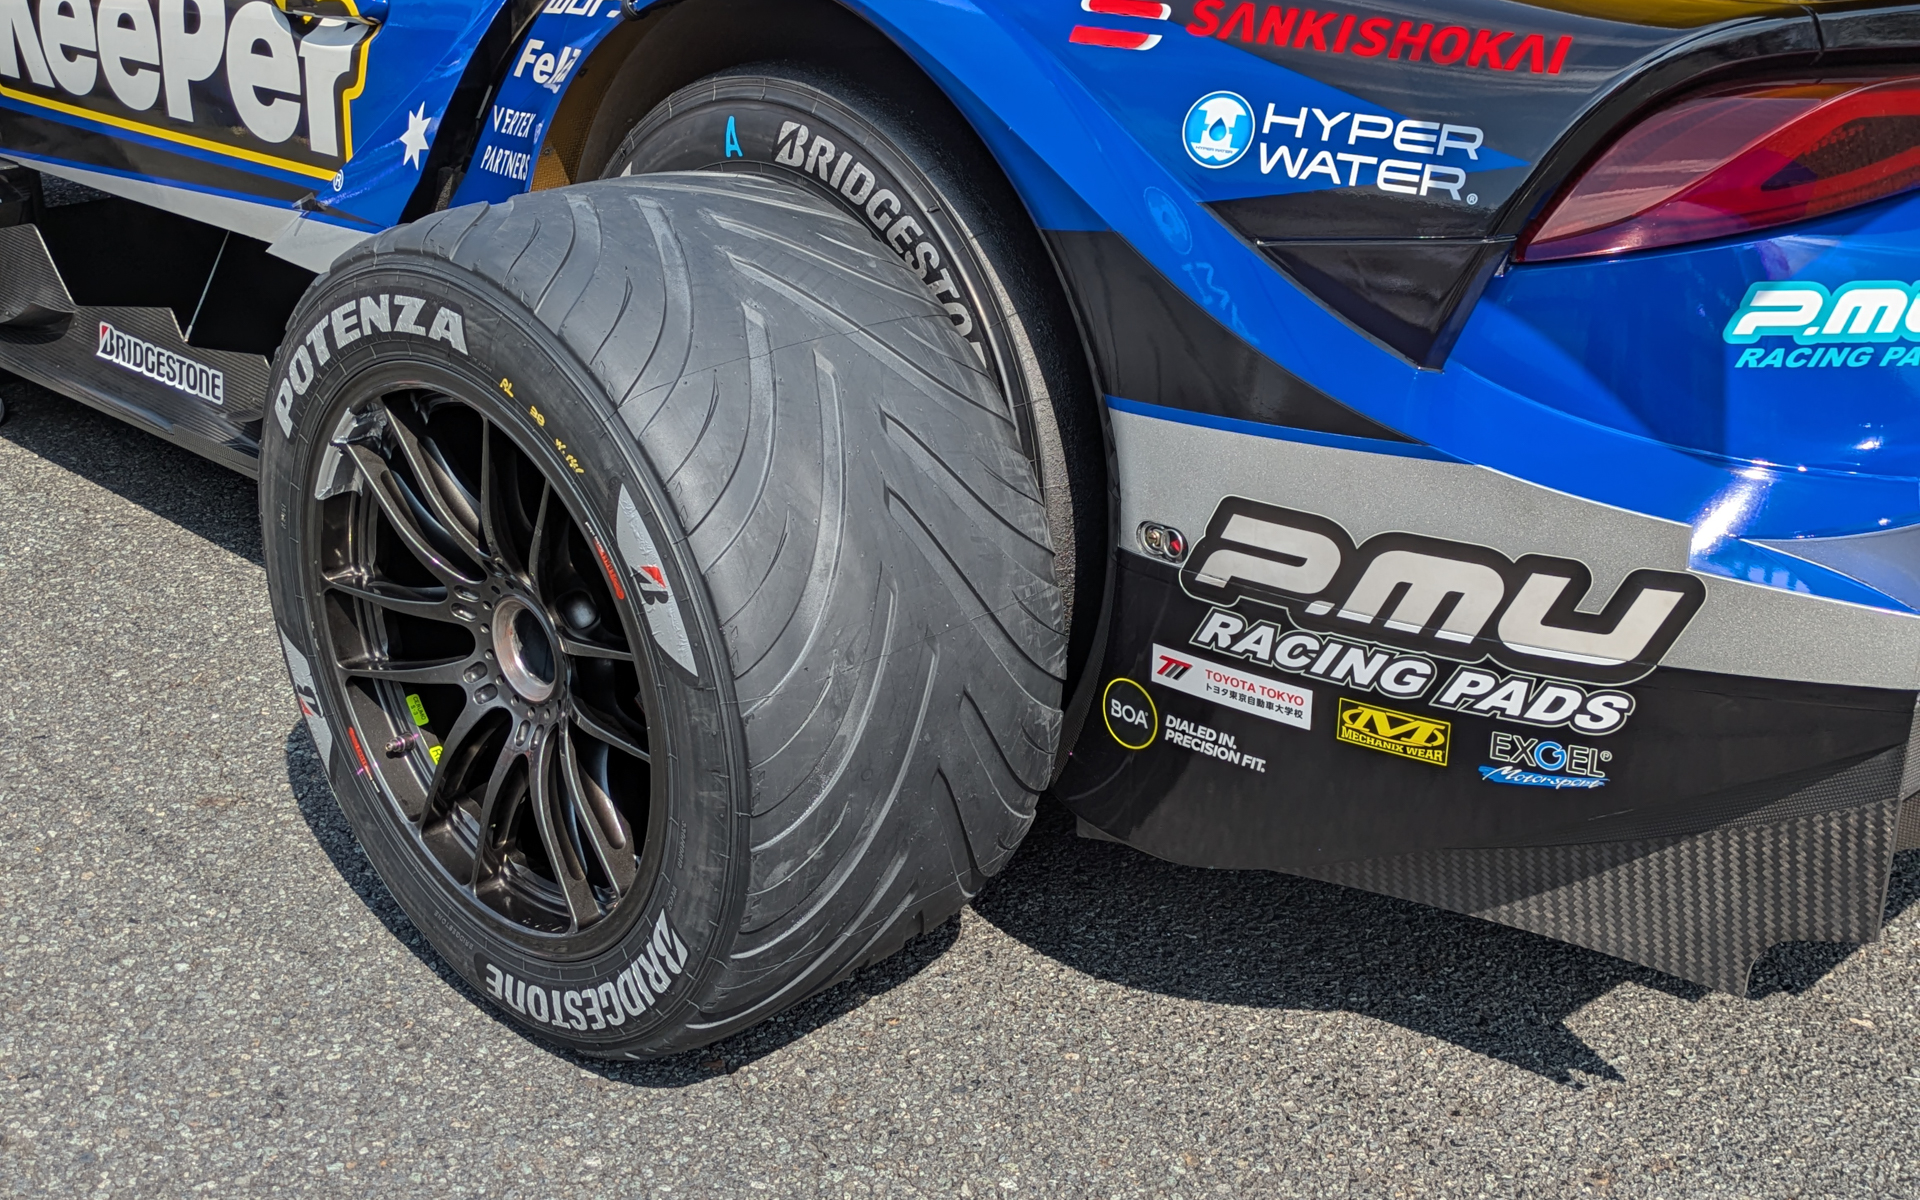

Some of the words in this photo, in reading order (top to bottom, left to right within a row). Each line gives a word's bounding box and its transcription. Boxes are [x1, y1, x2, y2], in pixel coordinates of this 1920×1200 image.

[1185, 0, 1574, 75] SANKISHOKAI
[493, 104, 537, 139] VERTEX
[724, 115, 743, 158] A
[1262, 102, 1484, 160] HYPER
[480, 145, 531, 181] PARTNERS
[775, 120, 988, 369] BRIDGESTO
[1732, 288, 1920, 336] P.M
[99, 322, 222, 404] BRIDGESTONE
[274, 294, 469, 438] POTENZA
[1735, 347, 1875, 368] RACING
[1199, 611, 1434, 692] RACING
[1439, 670, 1630, 731] PADS
[1205, 669, 1256, 694] TOYOTA
[1259, 685, 1305, 707] TOKYO
[1205, 683, 1304, 720] トヨタ東京自動車大学校
[1164, 728, 1241, 766] PRECISION
[1242, 756, 1266, 773] FIT.
[1165, 714, 1217, 742] DIALED
[1219, 731, 1237, 750] IN.
[1341, 726, 1404, 753] MECHANIX
[1405, 745, 1445, 762] WEAR
[1490, 731, 1605, 777] EXGEL
[1482, 766, 1604, 789] Motorsport
[486, 908, 689, 1031] BRIDGESTONE
